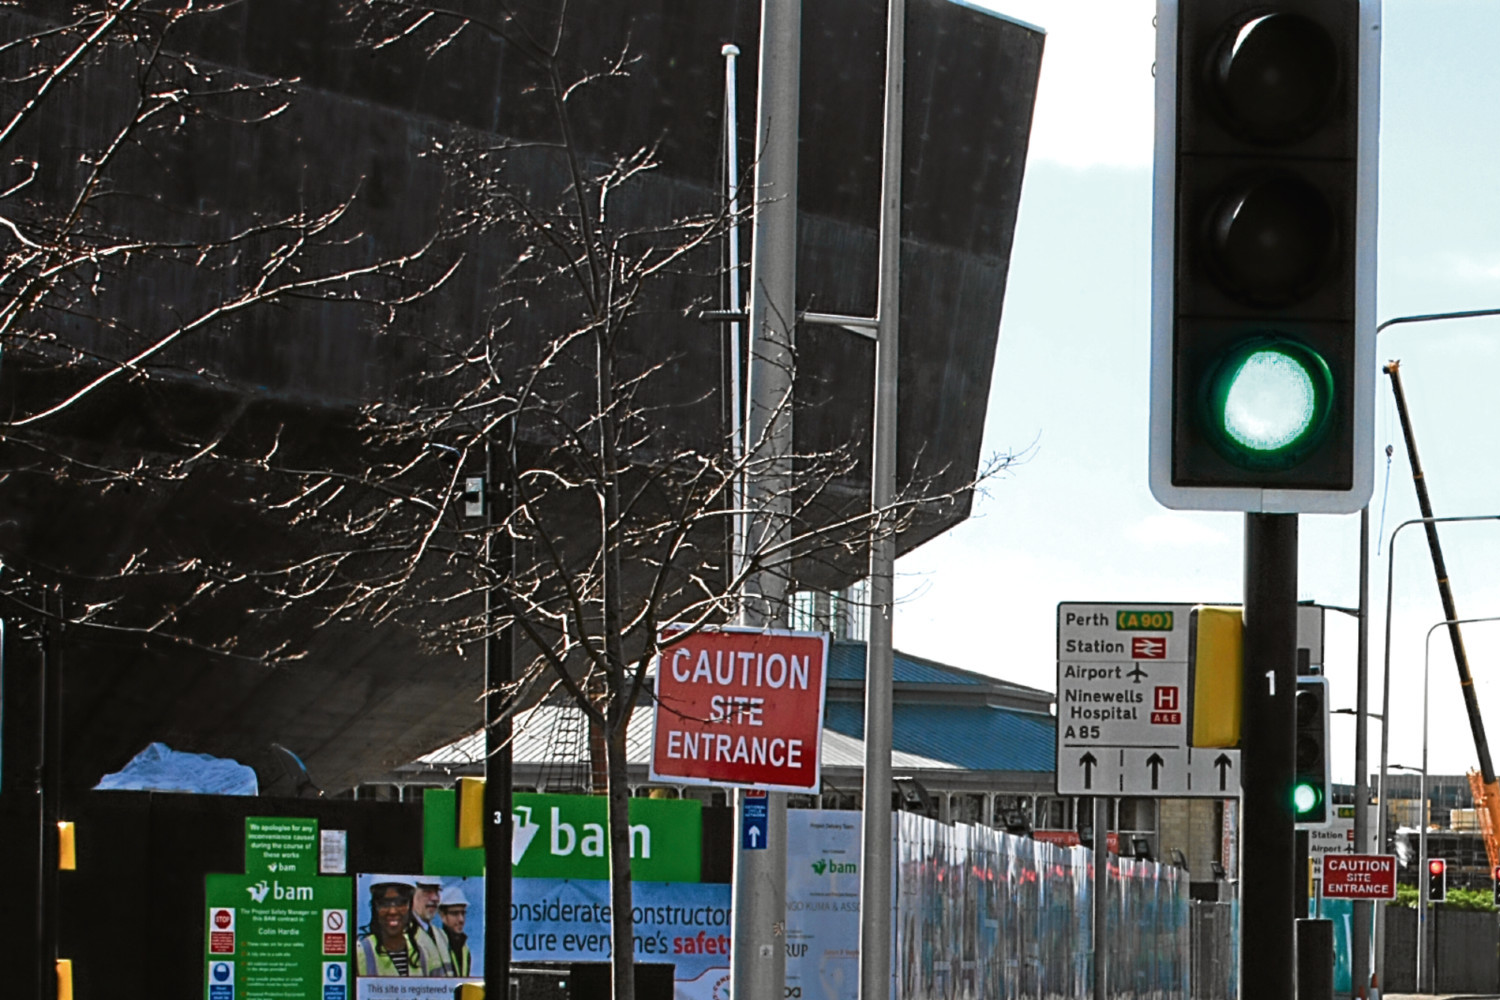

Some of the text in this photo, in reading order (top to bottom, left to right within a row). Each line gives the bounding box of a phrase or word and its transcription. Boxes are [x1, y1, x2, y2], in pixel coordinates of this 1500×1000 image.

[1066, 613, 1109, 627] Perth
[1065, 639, 1124, 653] Station
[672, 647, 810, 690] CAUTION
[1064, 665, 1122, 681] Airport
[1265, 670, 1276, 696] 1
[1065, 690, 1143, 703] Ninewells
[709, 695, 764, 726] SITE
[1071, 707, 1138, 721] Hospital
[667, 730, 803, 768] ENTRANCE
[493, 811, 501, 824] 3
[261, 824, 290, 832] apologise
[550, 807, 651, 859] bam
[1312, 831, 1343, 839] Station
[251, 842, 271, 850] during
[1311, 845, 1341, 853] Airport
[279, 862, 296, 872] bam
[829, 859, 857, 874] bam
[1328, 860, 1390, 872] CAUTION
[1346, 873, 1371, 883] SITE
[274, 880, 314, 901] bam
[1328, 883, 1389, 894] ENTRANCE
[511, 898, 732, 926] onsiderate onstructor
[258, 927, 276, 935] Colin
[785, 943, 809, 957] RUP
[368, 984, 383, 993] This
[385, 984, 399, 993] site
[401, 985, 407, 993] is
[408, 985, 447, 995] registered
